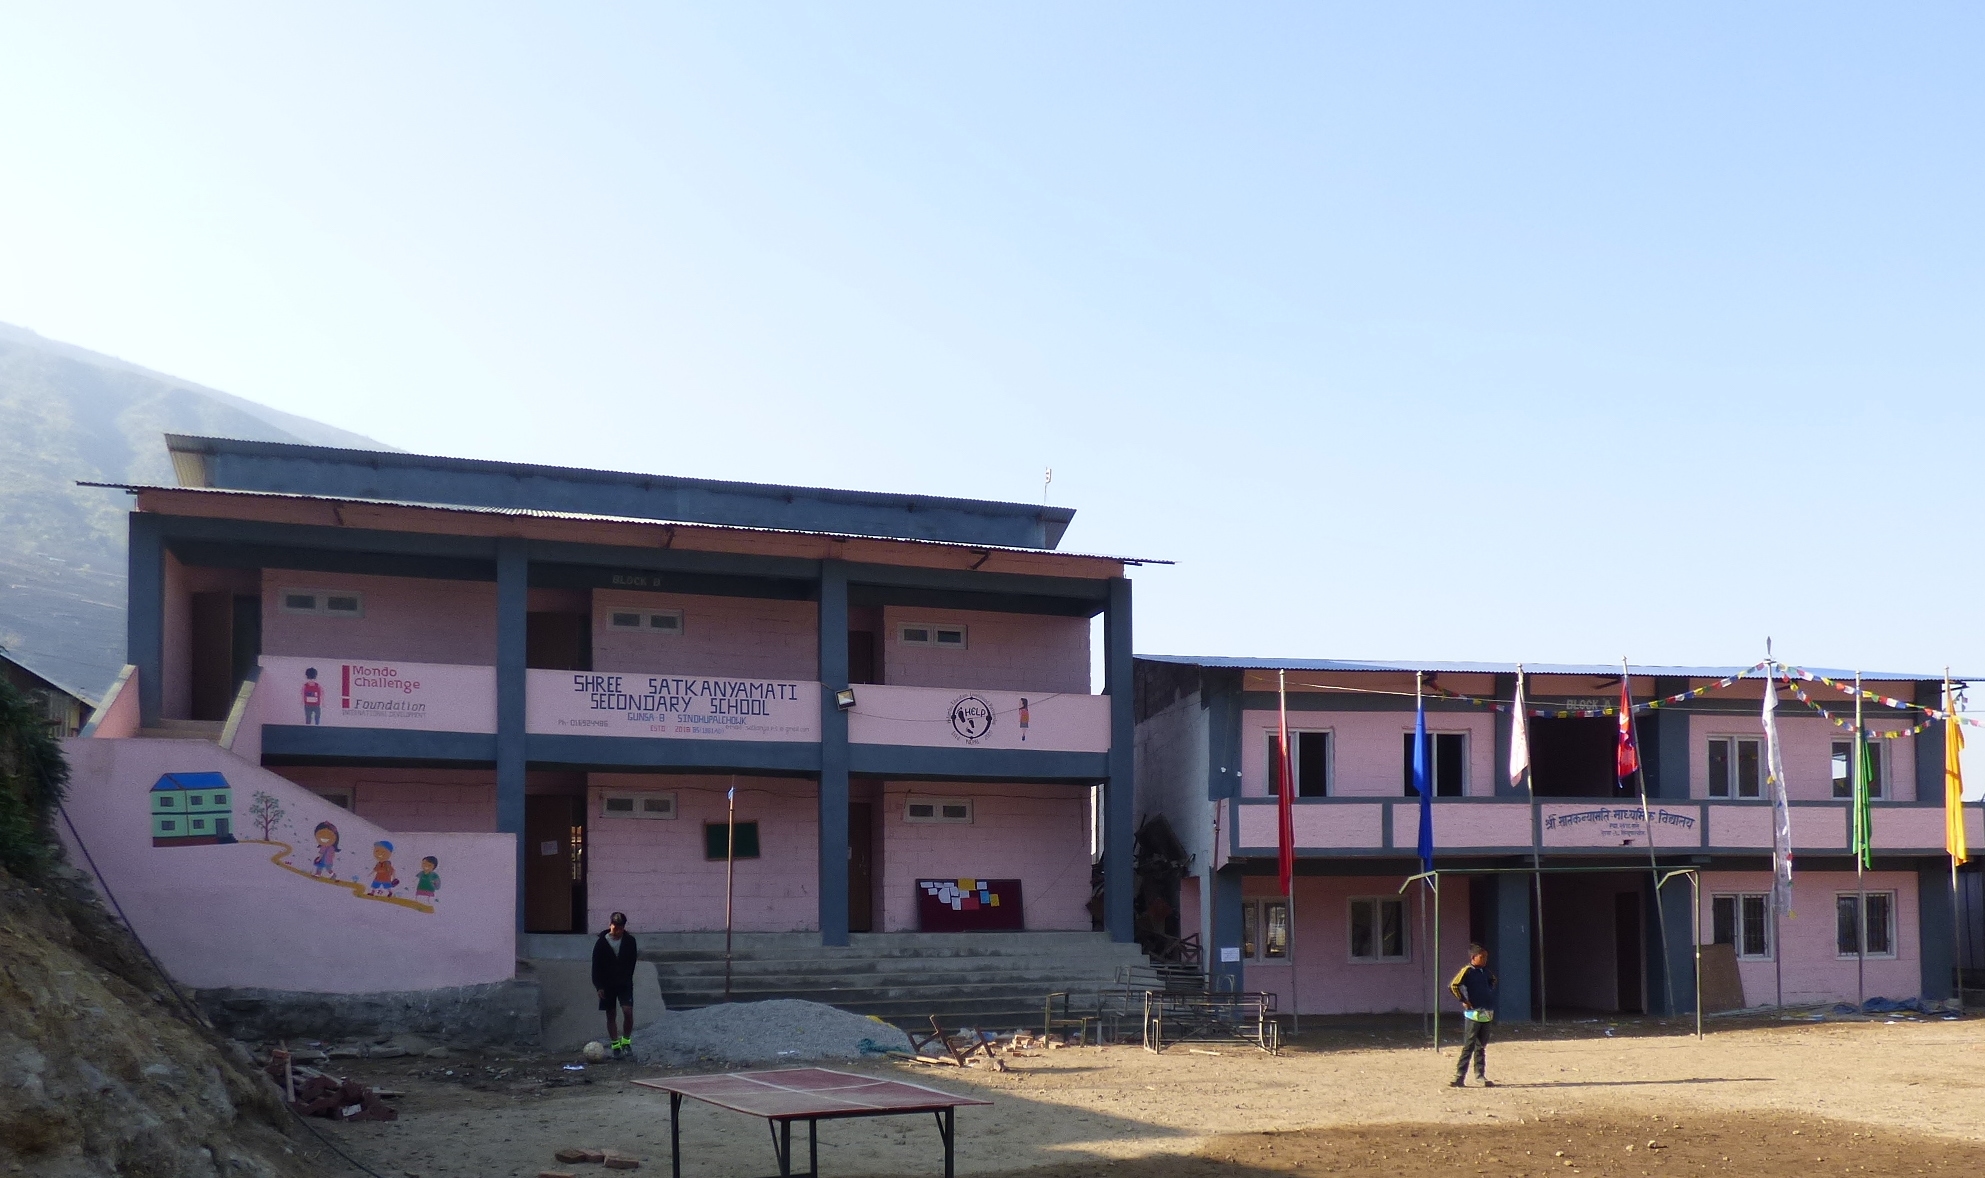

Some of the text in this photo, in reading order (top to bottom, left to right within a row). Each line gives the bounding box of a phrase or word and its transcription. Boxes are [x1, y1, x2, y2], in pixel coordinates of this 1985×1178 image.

[612, 574, 647, 586] BLOCK
[352, 665, 397, 677] Mondo
[354, 676, 421, 694] Challenge
[573, 674, 798, 700] SHREE SATKANYAMATI
[354, 699, 426, 712] Foundation
[590, 692, 770, 716] SECONDARY SCHOOL
[1566, 699, 1599, 710] BLOCK
[964, 706, 986, 718] HELP
[677, 713, 747, 725] SINDHUPALCHOWK
[1545, 814, 1557, 830] श्री
[1658, 808, 1696, 830] विद्यालय
